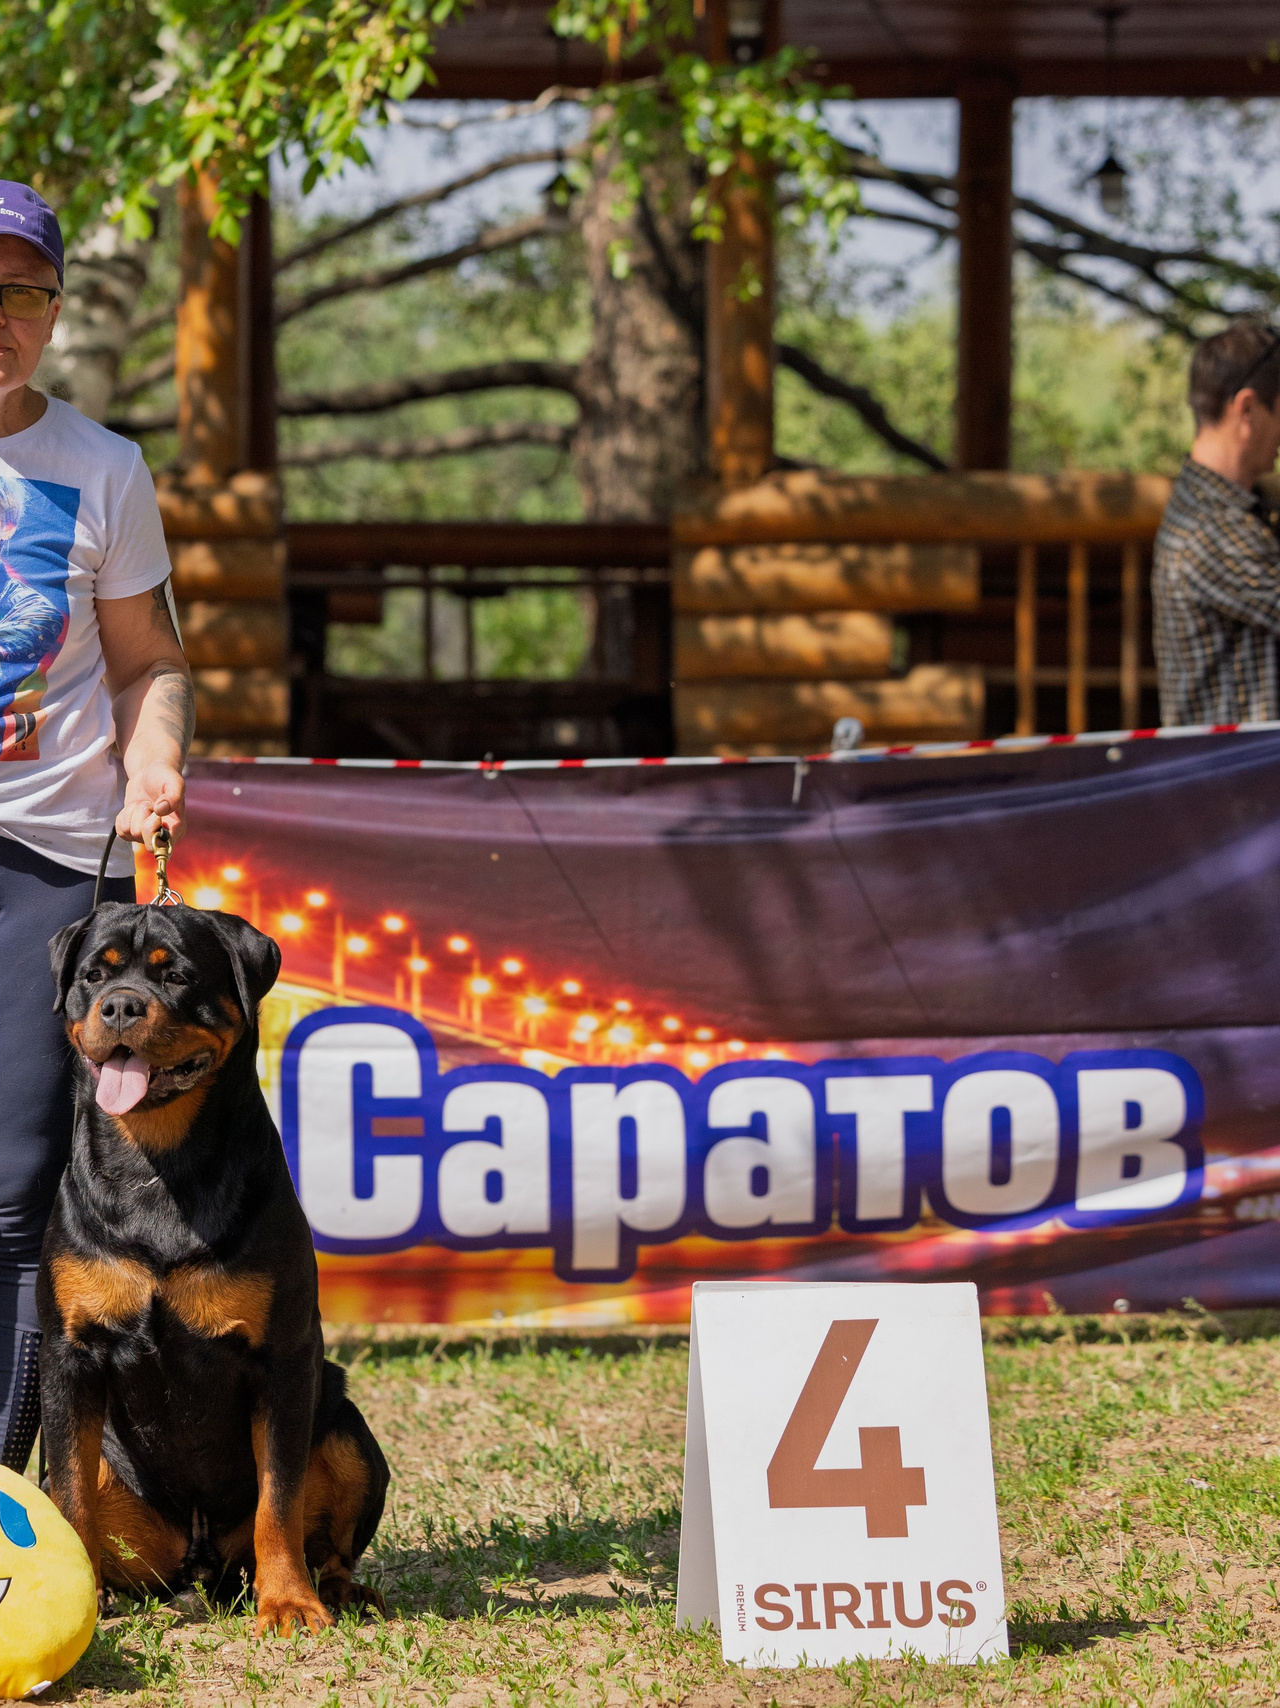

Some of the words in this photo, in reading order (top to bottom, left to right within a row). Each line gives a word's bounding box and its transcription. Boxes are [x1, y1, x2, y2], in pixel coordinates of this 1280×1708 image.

[297, 1022, 1188, 1271] Саратов
[766, 1318, 928, 1539] 4
[735, 1584, 747, 1632] PREMIUM
